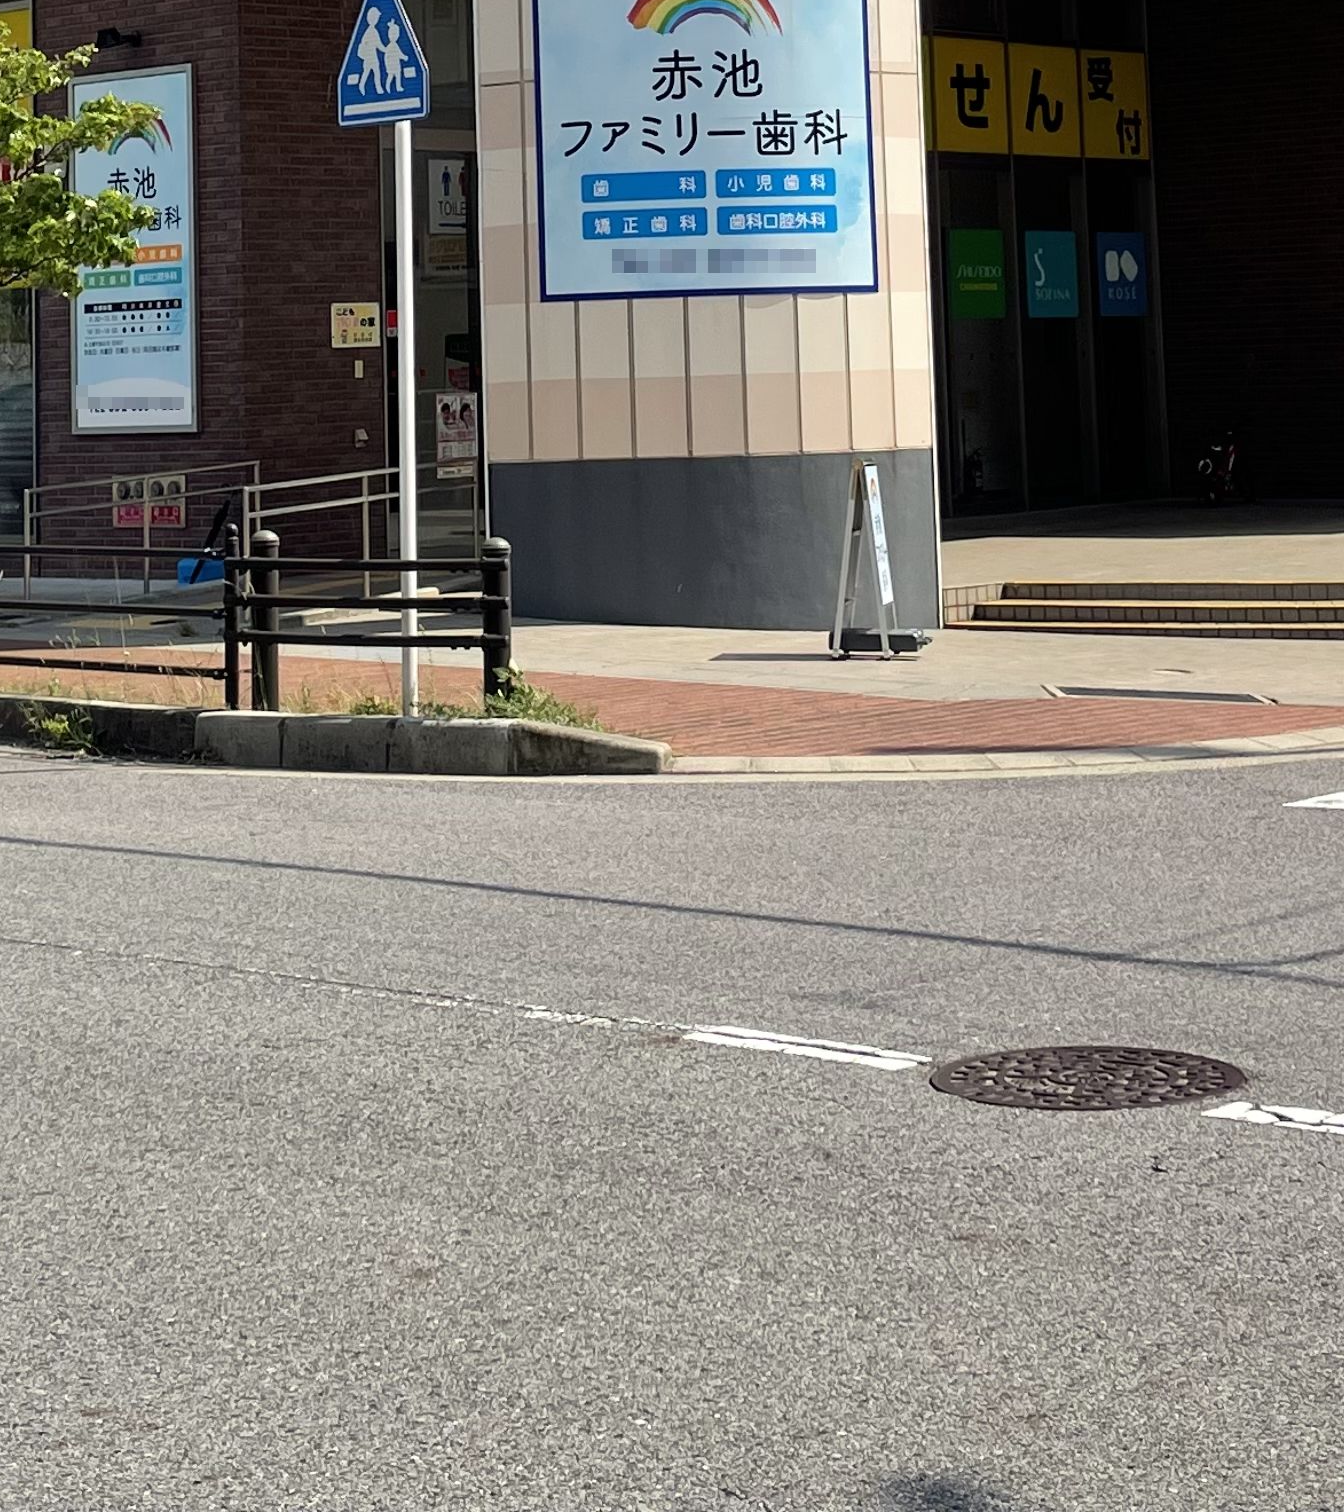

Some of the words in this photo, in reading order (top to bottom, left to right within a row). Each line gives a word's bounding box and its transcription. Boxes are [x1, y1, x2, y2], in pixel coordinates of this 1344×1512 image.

[651, 48, 764, 102] 赤池
[560, 109, 848, 158] ファミリー歯科
[107, 166, 157, 199] 赤池
[592, 175, 697, 198] 歯科
[727, 173, 826, 193] 小児歯科
[438, 200, 466, 216] TOILE
[594, 214, 697, 236] 矯正歯科
[728, 212, 826, 231] 歯科口腔外科
